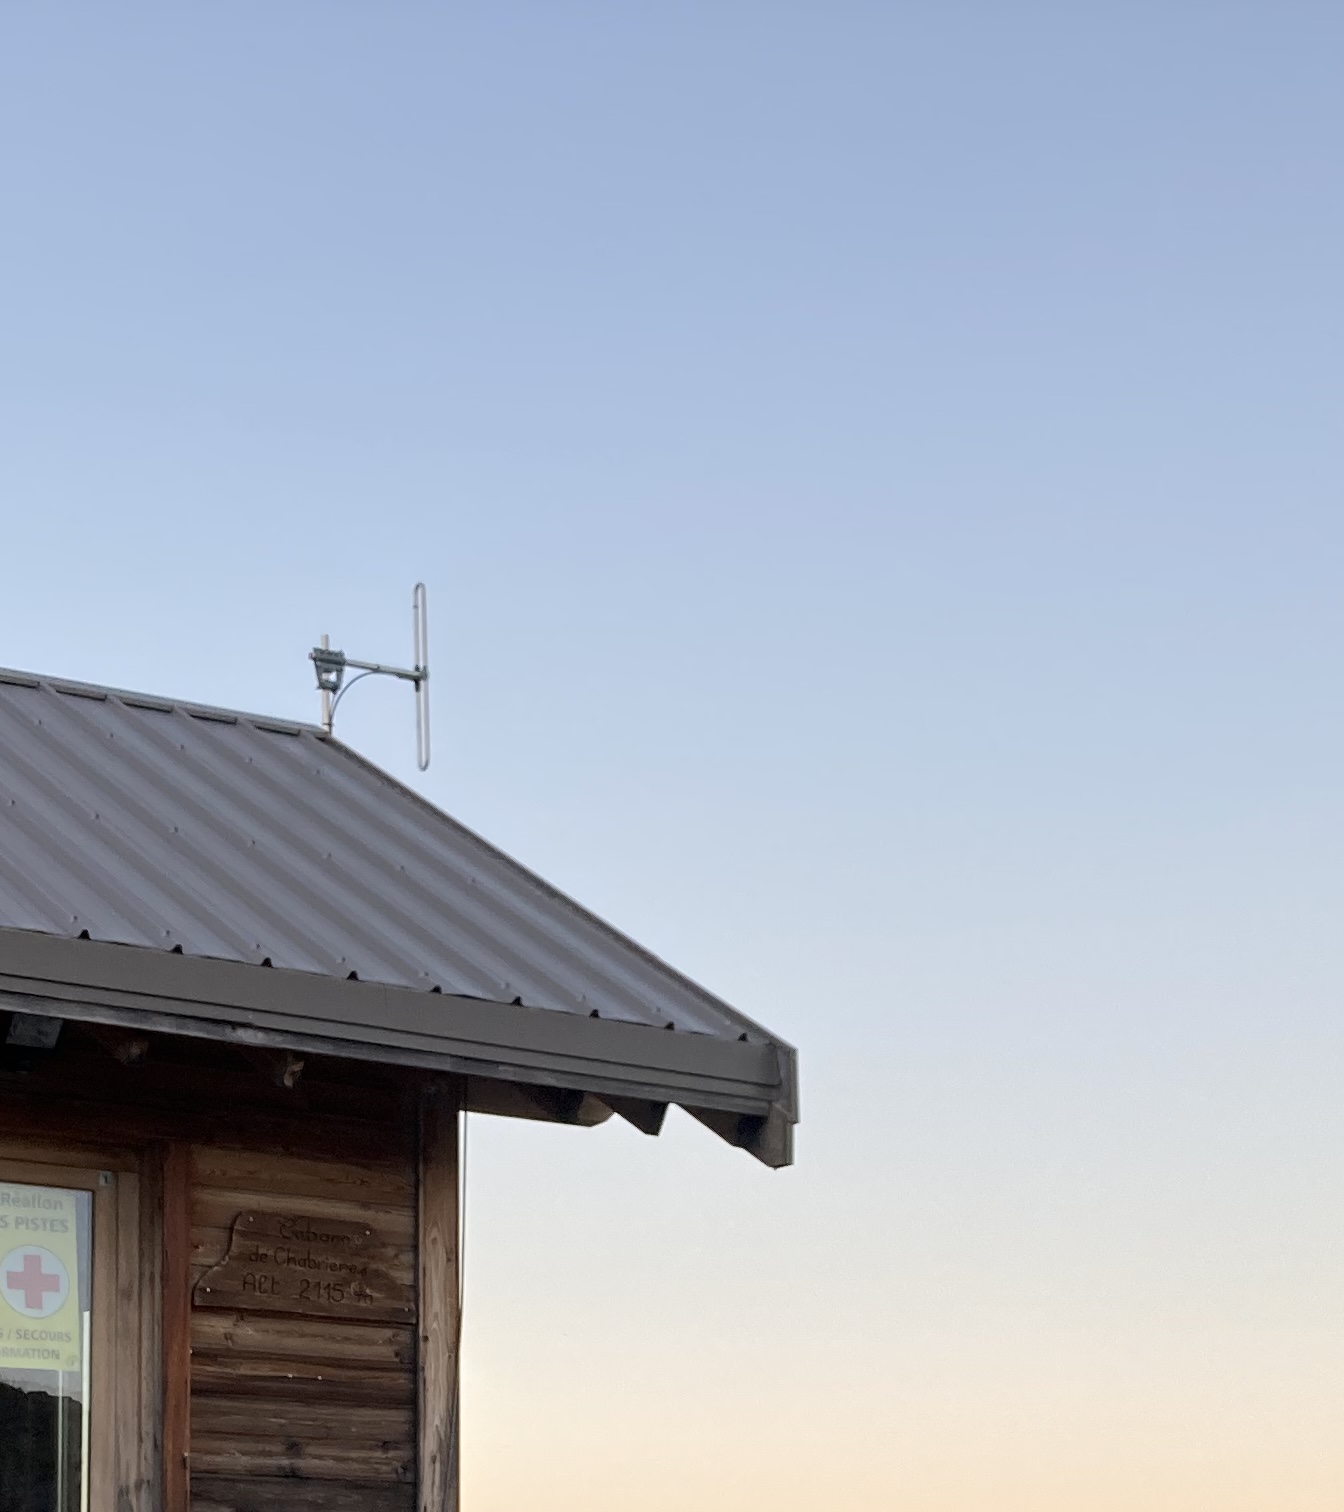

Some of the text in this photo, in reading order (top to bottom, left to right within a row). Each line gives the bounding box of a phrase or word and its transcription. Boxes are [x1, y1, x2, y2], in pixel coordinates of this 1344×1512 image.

[14, 1216, 69, 1234] PISTES
[249, 1245, 268, 1263] de
[299, 1278, 345, 1303] 2115
[16, 1329, 72, 1344] SECOURS
